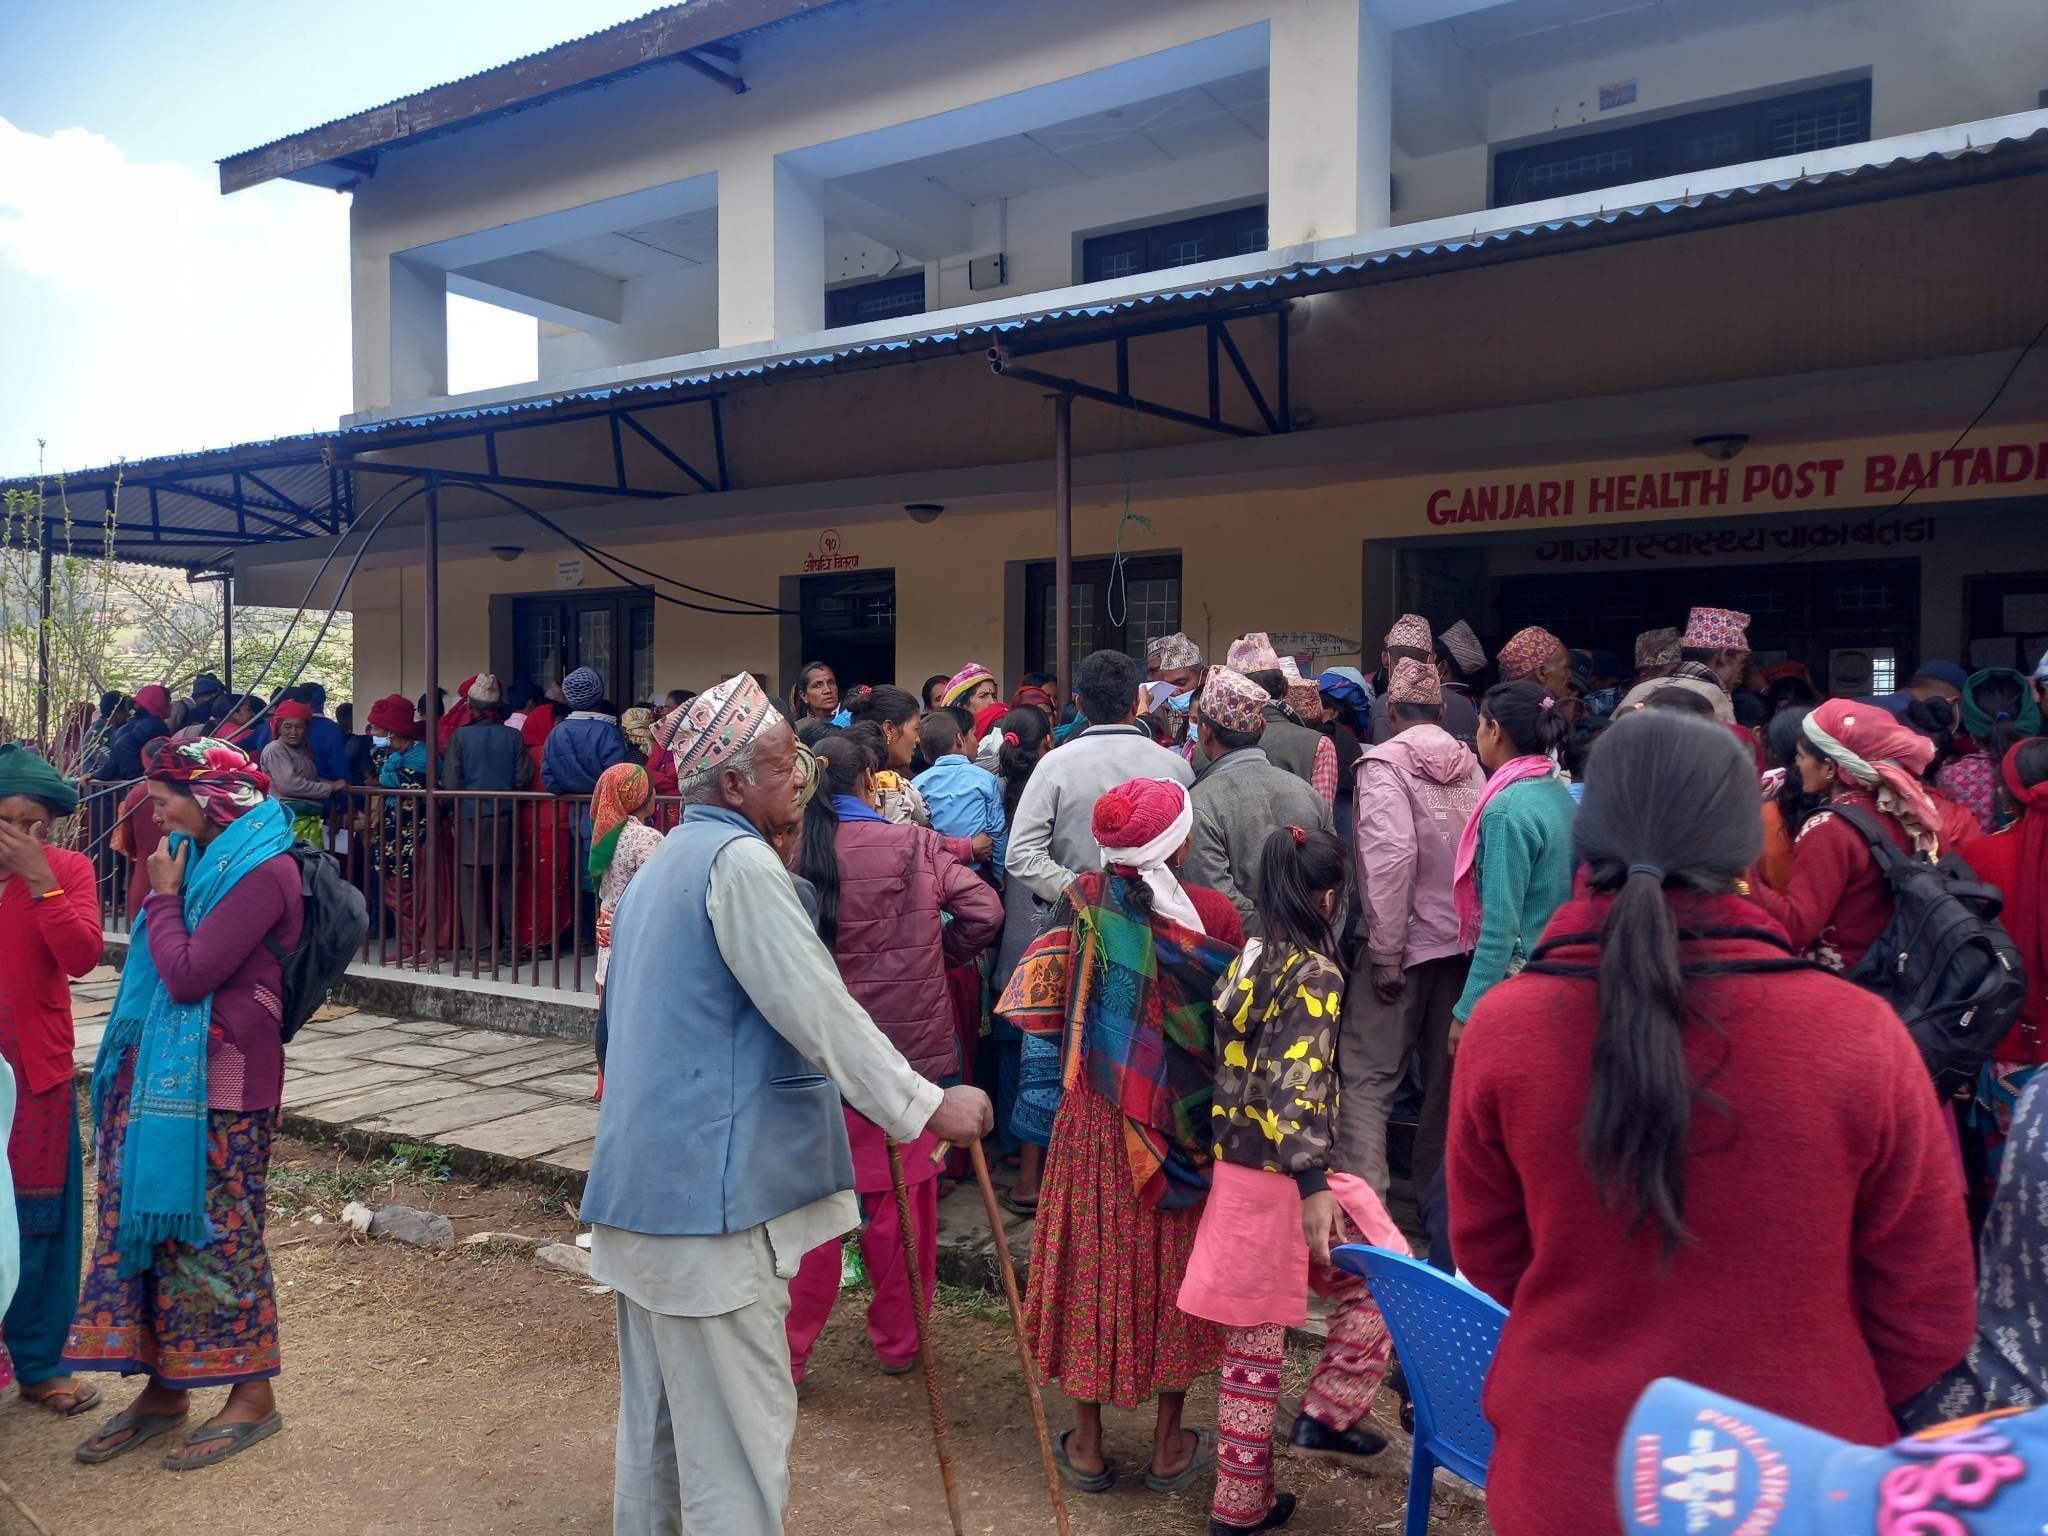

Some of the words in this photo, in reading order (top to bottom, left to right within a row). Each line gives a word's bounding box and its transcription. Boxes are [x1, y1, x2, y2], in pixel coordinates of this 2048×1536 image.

[1427, 479, 1575, 526] GANJARI
[1588, 468, 1729, 513] HEALTH
[1743, 459, 1844, 502] POST
